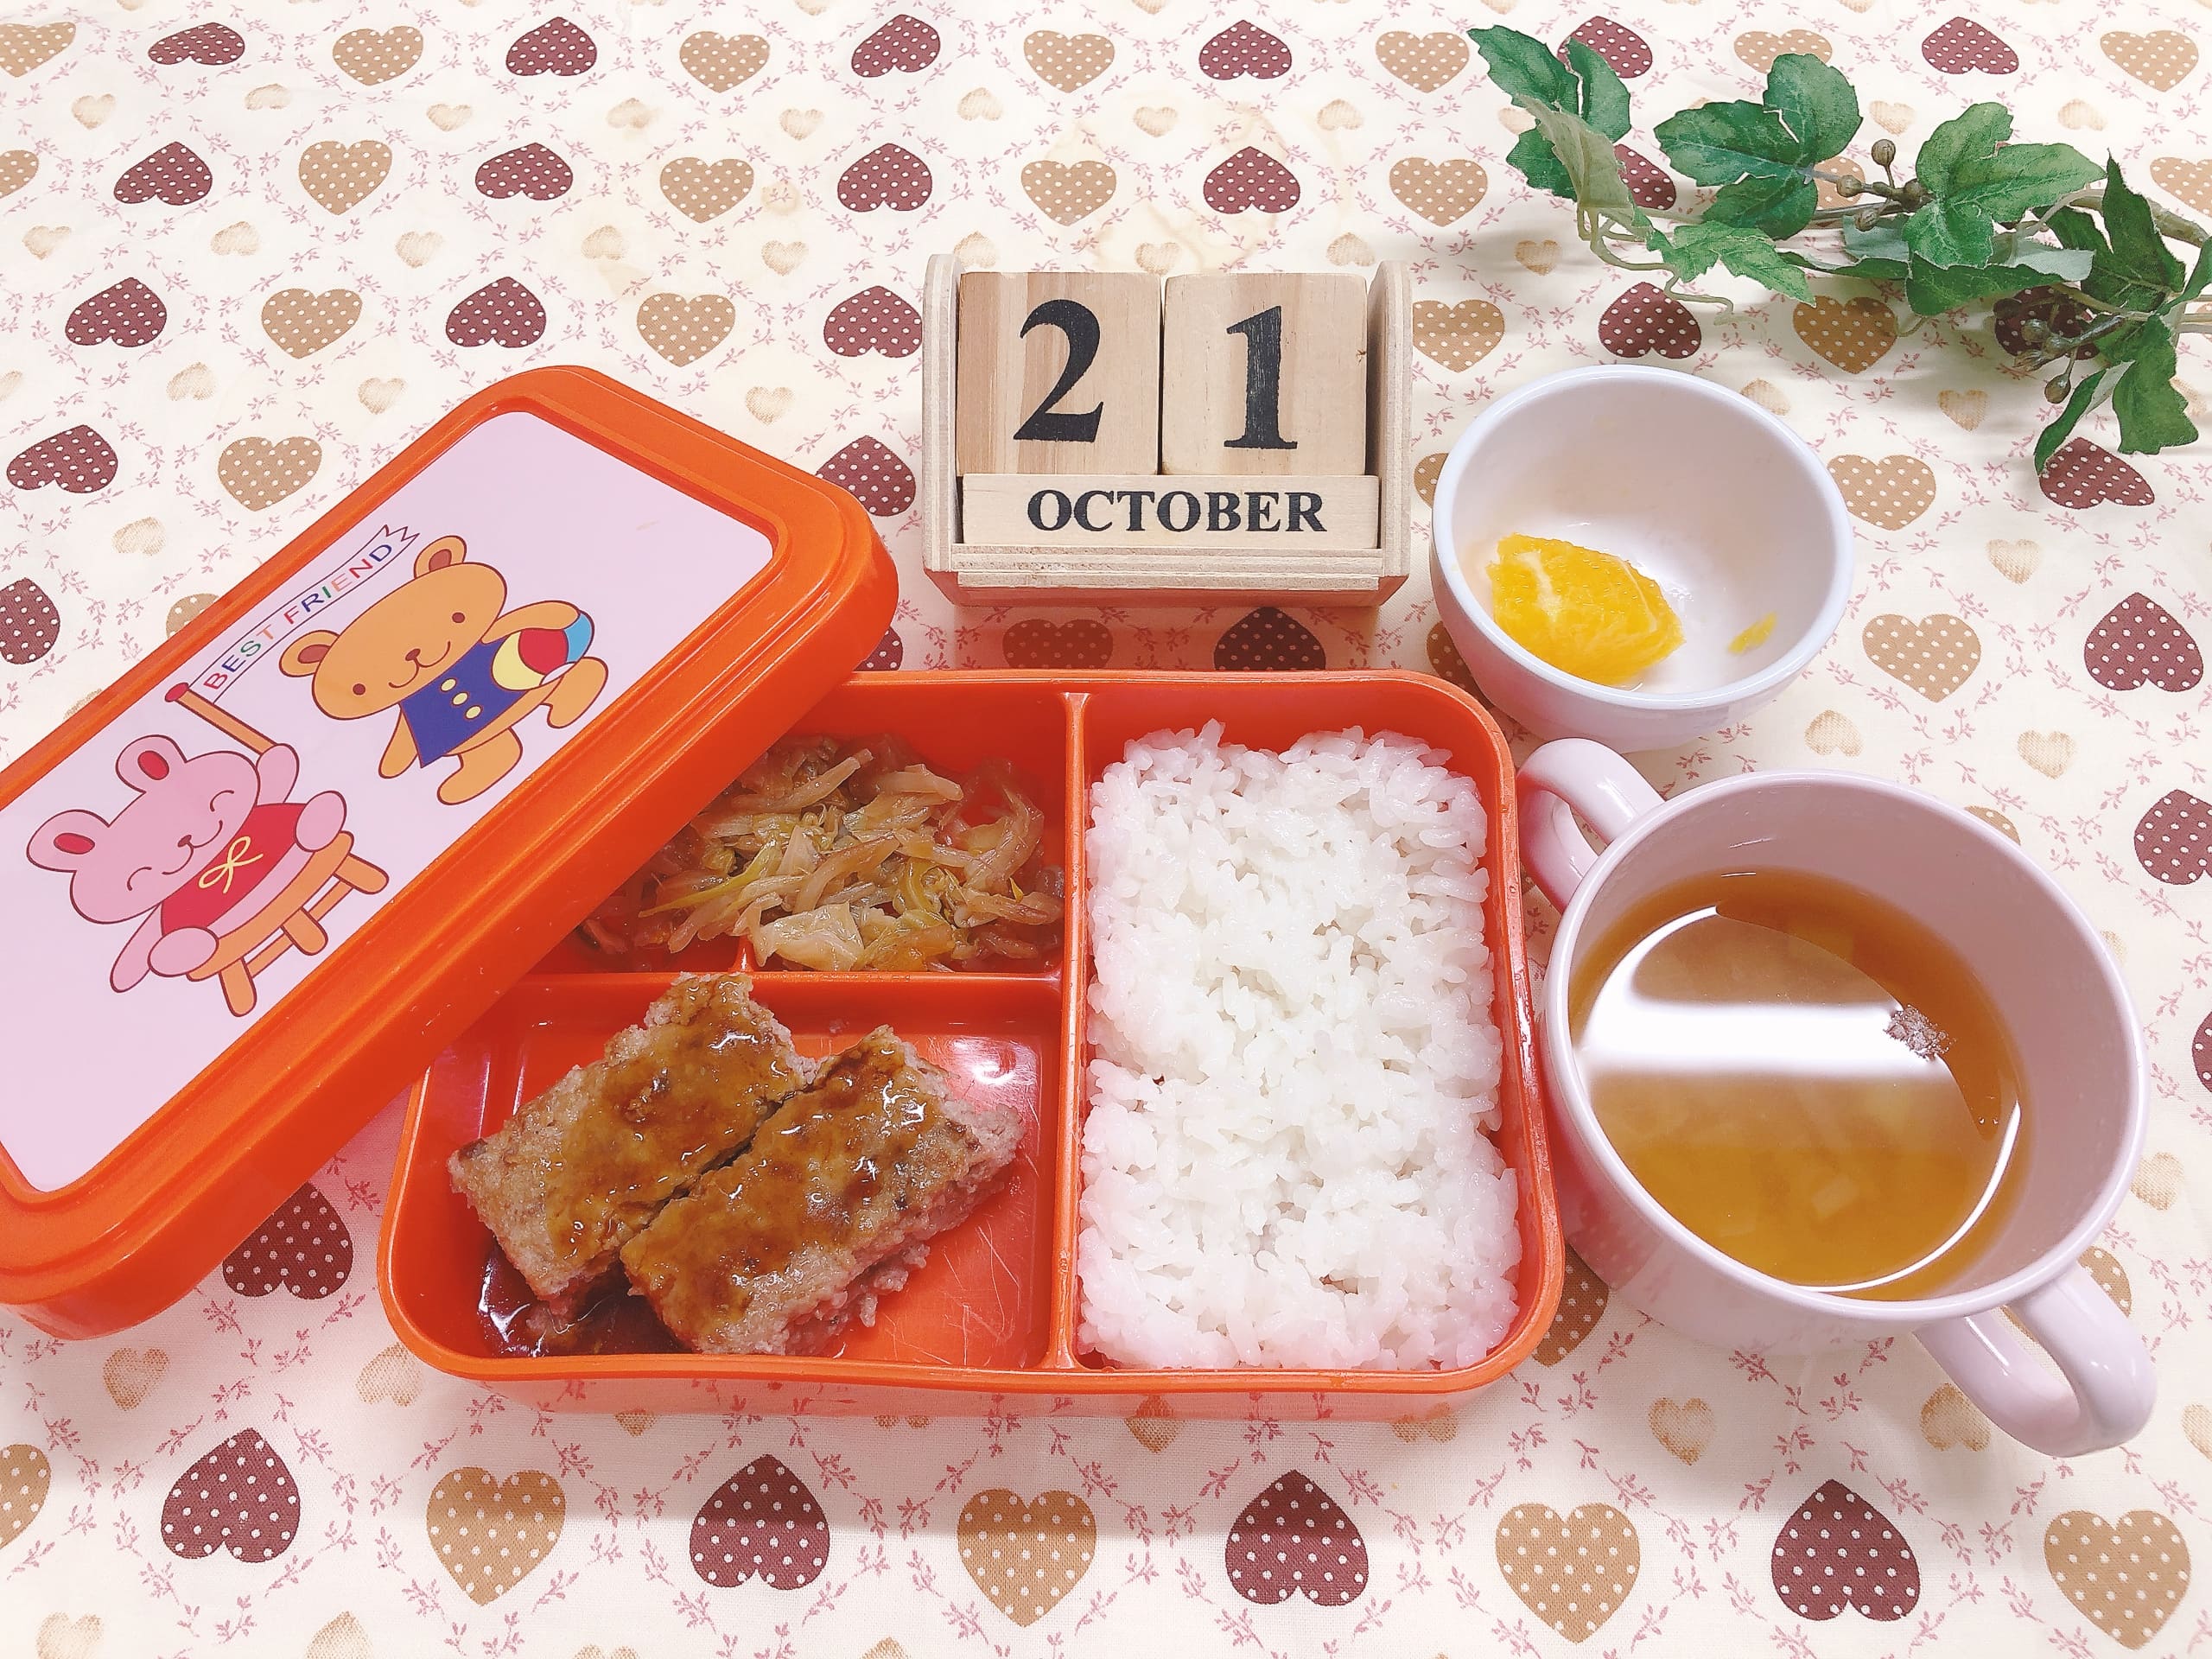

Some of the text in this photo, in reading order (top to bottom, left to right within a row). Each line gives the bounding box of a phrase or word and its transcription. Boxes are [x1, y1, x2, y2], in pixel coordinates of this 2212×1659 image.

[1027, 489, 1327, 532] OCTOBER
[203, 543, 392, 690] BEST FRIEND
